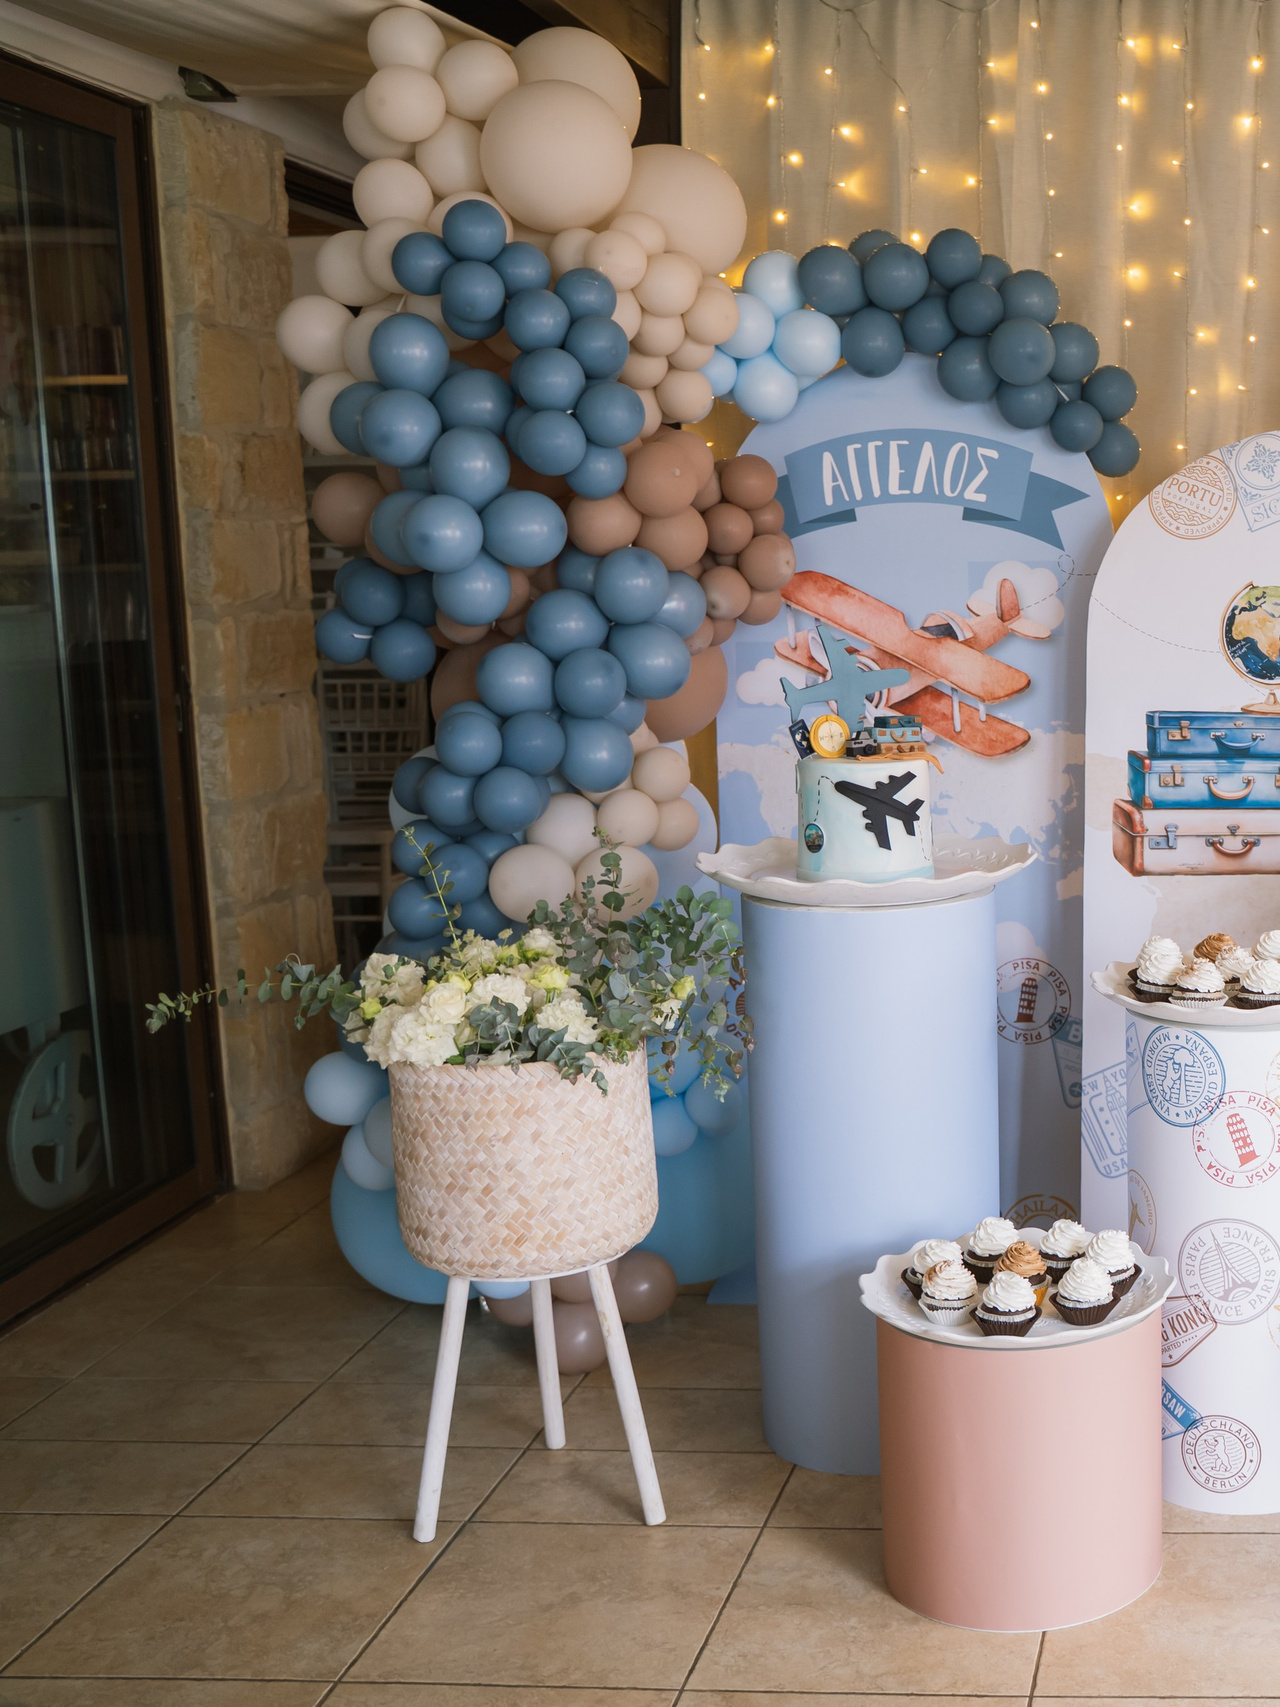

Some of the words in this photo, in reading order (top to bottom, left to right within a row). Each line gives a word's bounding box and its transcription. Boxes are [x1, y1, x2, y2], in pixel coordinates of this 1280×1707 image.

[822, 440, 999, 506] ΑΓΓΕΛΟΣ
[1213, 464, 1233, 503] APPROVED
[1153, 490, 1174, 527] APPROVED
[1184, 515, 1224, 535] APPROVED
[1012, 961, 1040, 971] PISA
[1048, 970, 1068, 997] PISA
[1048, 1005, 1068, 1032] PISA
[1014, 1031, 1042, 1042] PISA
[1146, 1031, 1171, 1068] MADRID
[1185, 1034, 1218, 1076] ESPAÑA
[1082, 1079, 1098, 1096] EW
[1146, 1073, 1170, 1116] ESPAÑA
[1184, 1081, 1218, 1120] MADRID
[1206, 1094, 1236, 1114] PISA
[1247, 1095, 1276, 1117] PISA
[1102, 1157, 1128, 1175] USA
[1206, 1161, 1235, 1184] PISA
[1246, 1162, 1276, 1184] PISA
[1010, 1200, 1074, 1225] HAILAN
[1185, 1236, 1206, 1277] PARIS
[1222, 1226, 1275, 1263] FRANCE
[1190, 1283, 1243, 1317] FRANCE
[1248, 1269, 1277, 1310] PARIS
[1185, 1419, 1255, 1455] DEUTSCHLAND
[1204, 1472, 1247, 1489] BERLIN
